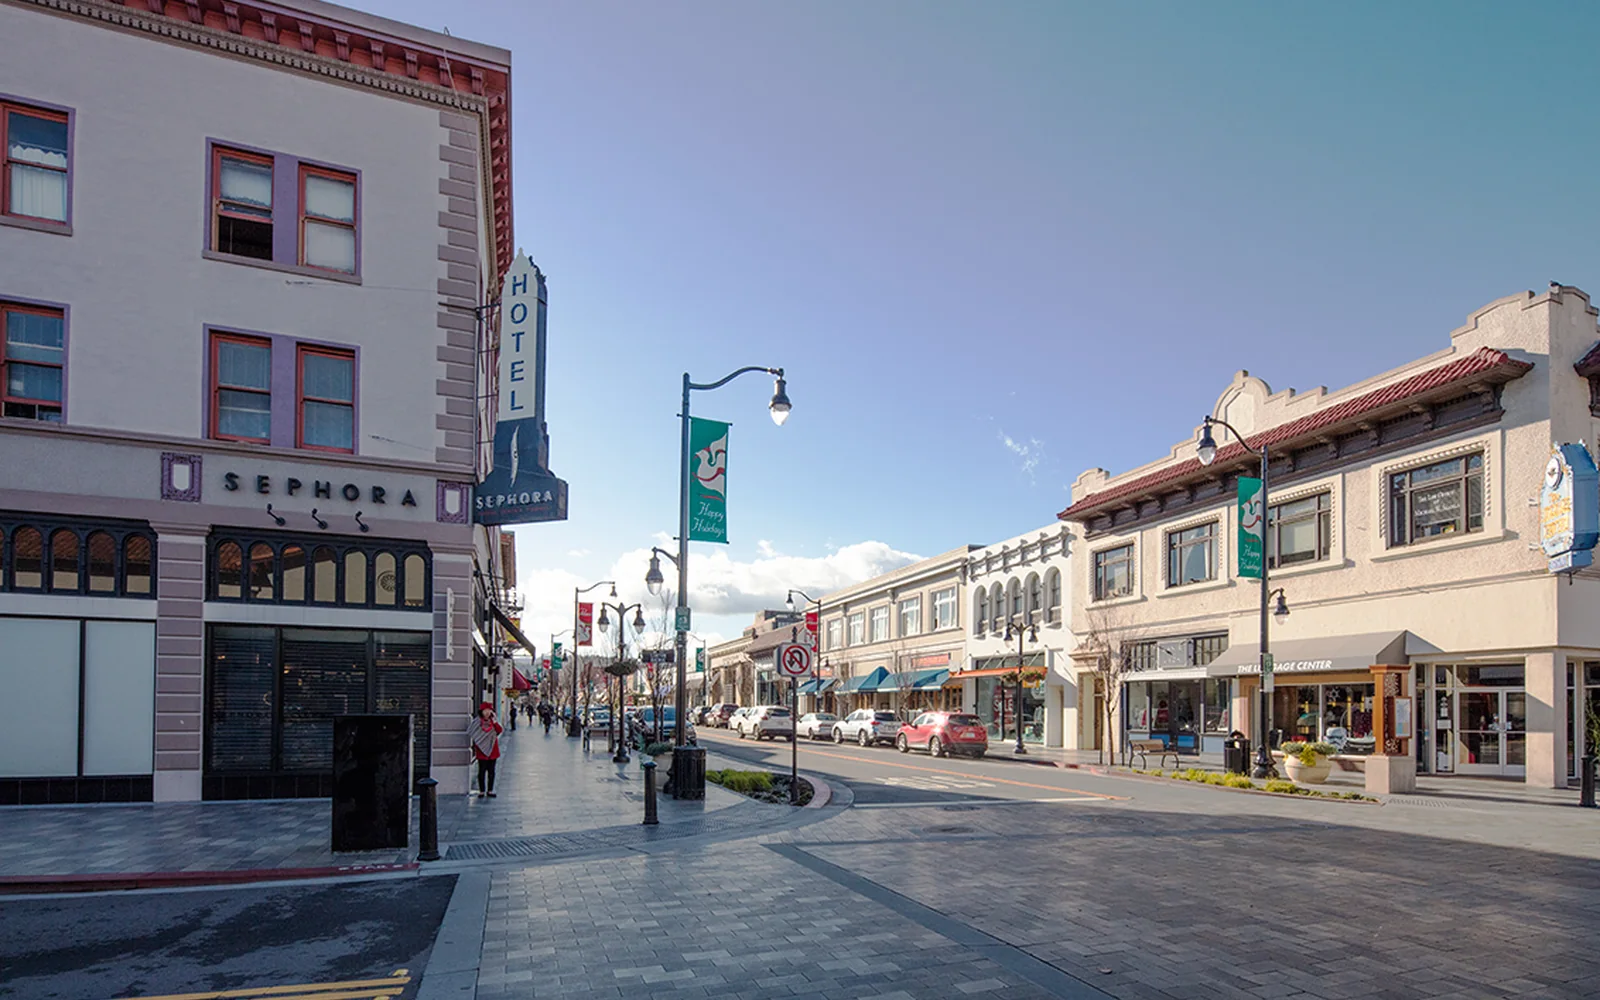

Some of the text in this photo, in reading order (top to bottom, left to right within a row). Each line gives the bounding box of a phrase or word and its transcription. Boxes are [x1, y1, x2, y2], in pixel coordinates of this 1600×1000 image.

[510, 273, 528, 411] HOTEL
[224, 471, 417, 507] SEPHORA
[475, 490, 552, 509] SEPHORA
[698, 501, 724, 523] Happy
[691, 517, 725, 538] Holidays
[1237, 665, 1252, 674] THE
[1253, 662, 1296, 673] LUGAGE
[1296, 660, 1333, 670] CENTER
